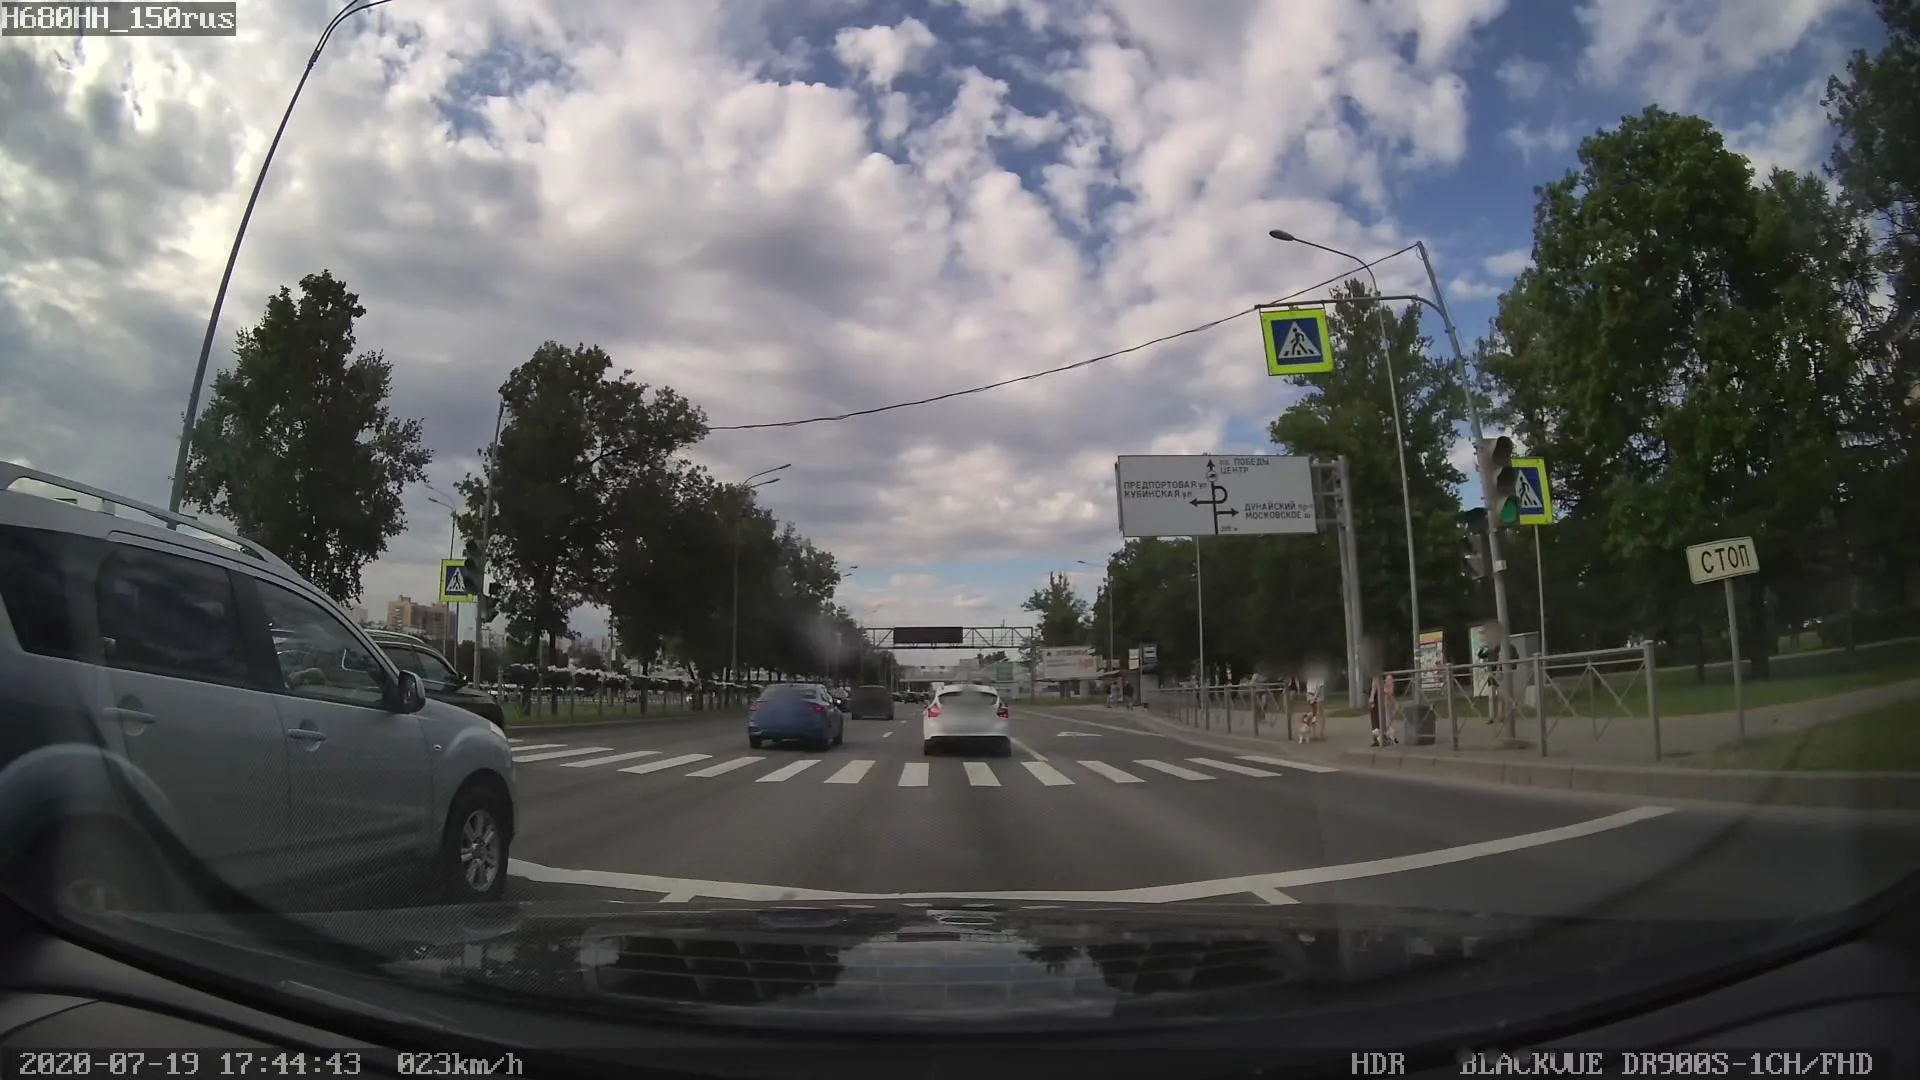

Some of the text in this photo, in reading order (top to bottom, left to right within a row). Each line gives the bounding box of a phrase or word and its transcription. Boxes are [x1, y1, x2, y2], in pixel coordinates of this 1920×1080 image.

[1234, 458, 1269, 466] ПОБЕДЫ
[1221, 466, 1249, 474] ЦЕНТР
[1124, 481, 1197, 489] ПРЕДПОРТОВАЯ
[1124, 490, 1180, 498] КУБИНСКАЯ
[1245, 501, 1296, 511] ДУНАЙСКИЙ
[1245, 511, 1302, 520] МОСКОВСКОЕ
[1701, 545, 1750, 573] СТОП
